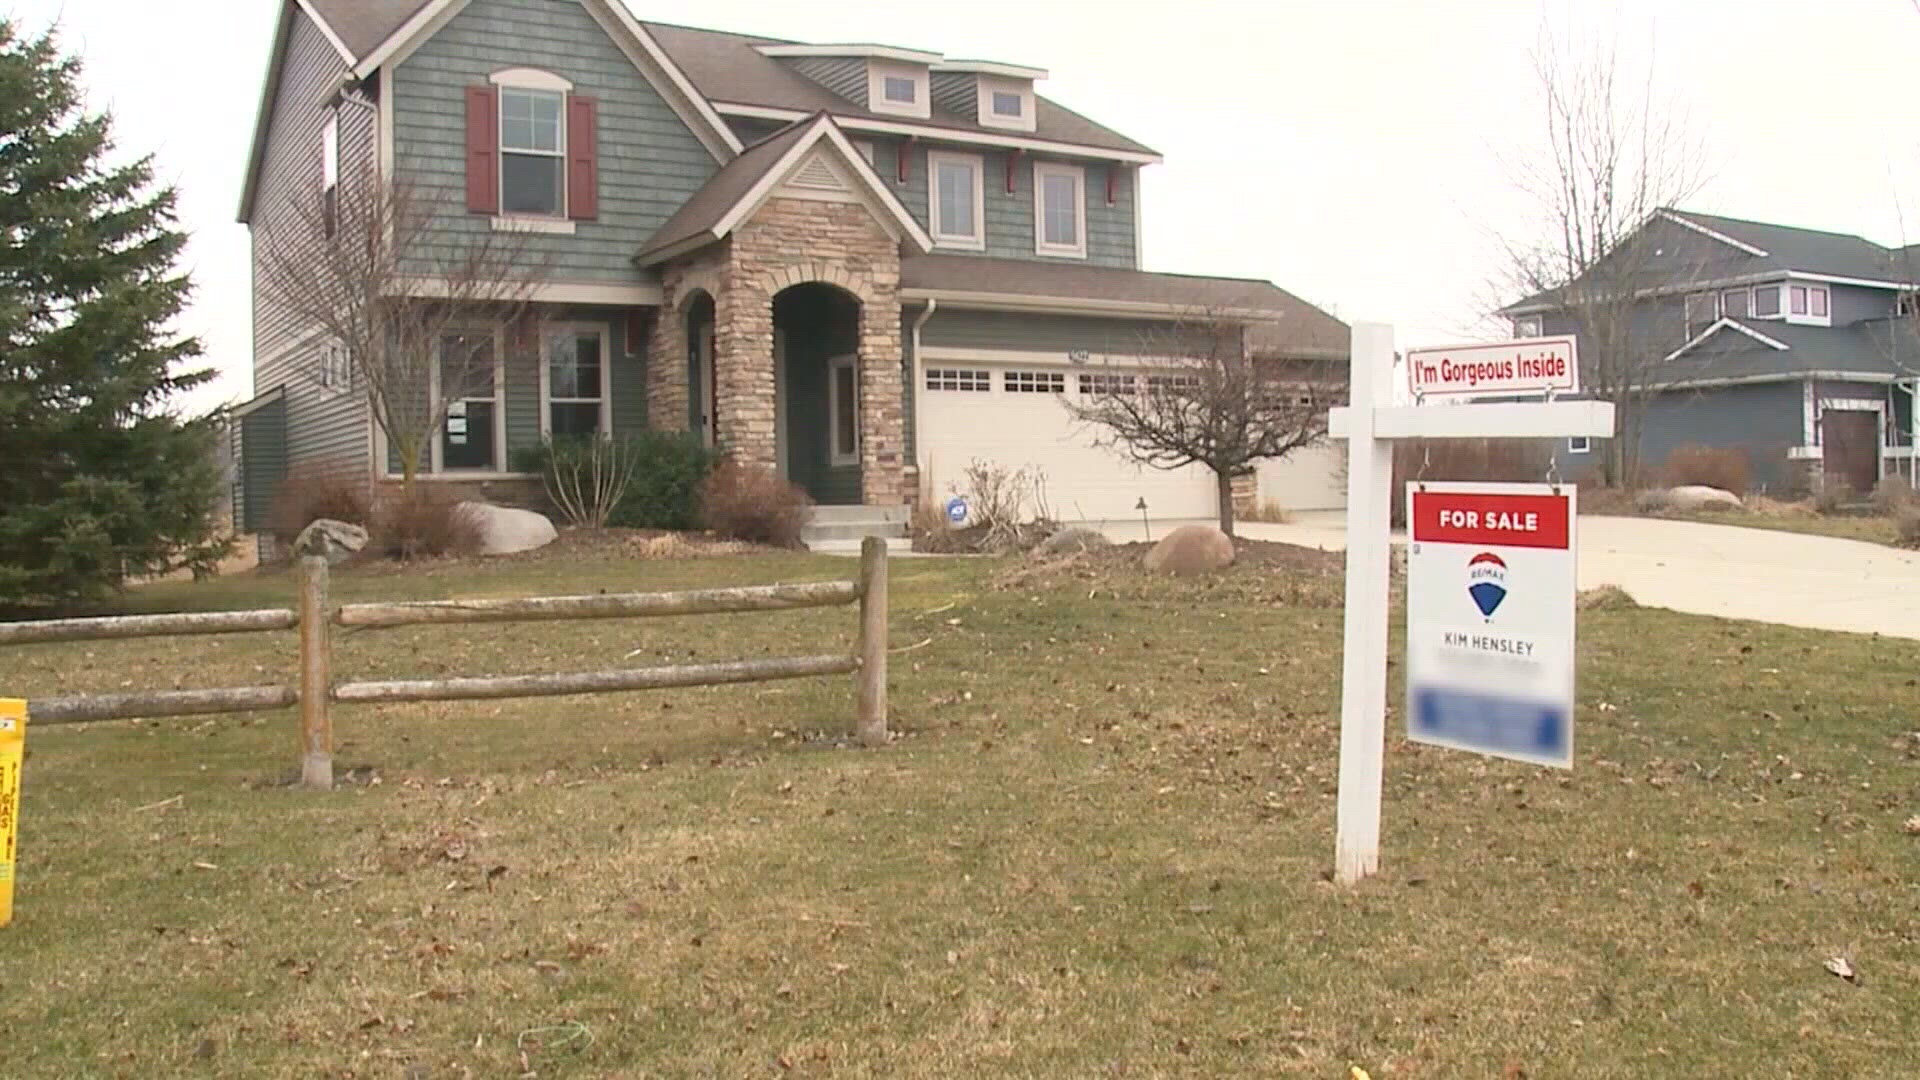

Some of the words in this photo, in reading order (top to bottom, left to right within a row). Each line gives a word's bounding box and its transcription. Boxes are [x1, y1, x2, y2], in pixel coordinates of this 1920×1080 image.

[1415, 359, 1438, 384] I'm
[1441, 357, 1513, 387] Gorgeous
[1517, 352, 1566, 378] Inside
[1440, 509, 1479, 529] FOR
[1485, 512, 1538, 531] SALE
[1444, 631, 1468, 647] KIM
[1472, 636, 1534, 656] HENSLEY
